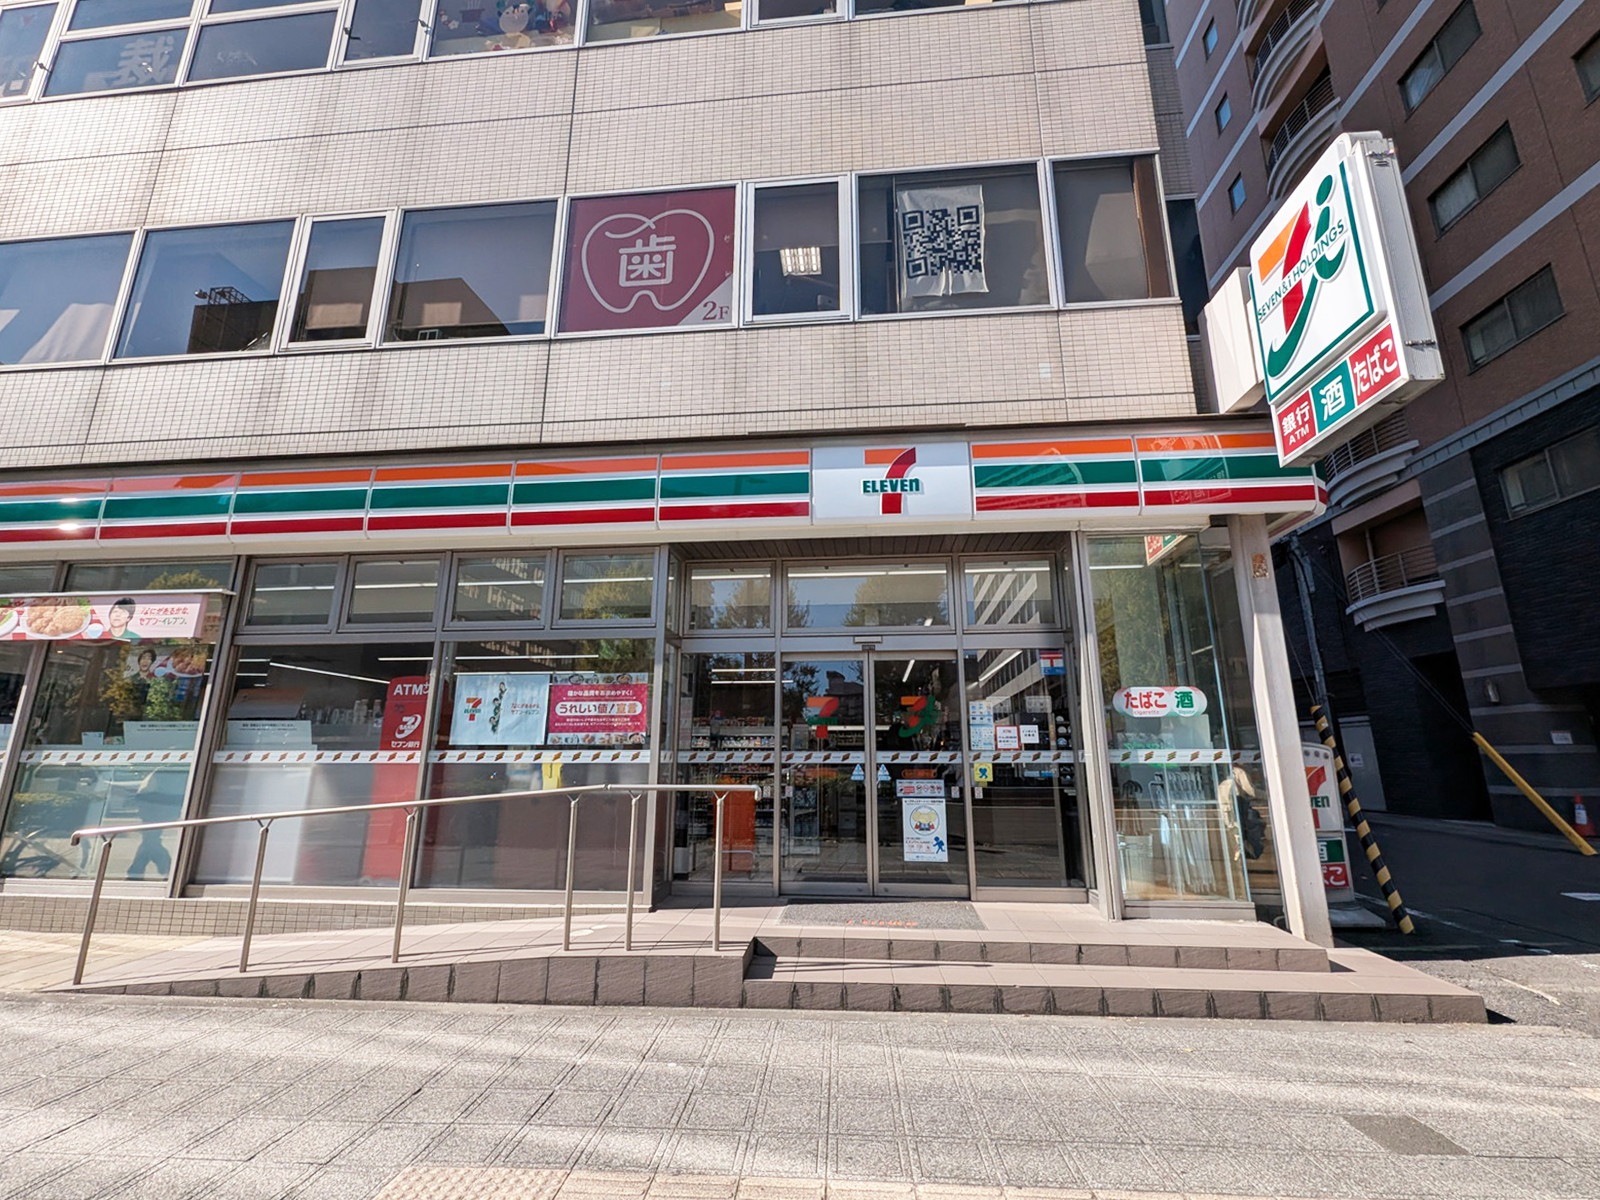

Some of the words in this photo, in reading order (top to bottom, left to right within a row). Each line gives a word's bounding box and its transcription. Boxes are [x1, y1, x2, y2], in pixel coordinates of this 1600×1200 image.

[619, 234, 677, 288] 歯
[1293, 219, 1345, 283] HOLDINGS
[702, 300, 730, 321] 2F
[1281, 400, 1310, 436] 銀行
[1319, 374, 1346, 421] 酒
[1353, 338, 1398, 397] たばこ
[1288, 424, 1310, 446] ATM
[1124, 691, 1167, 709] たばこ
[1174, 691, 1195, 709] 酒
